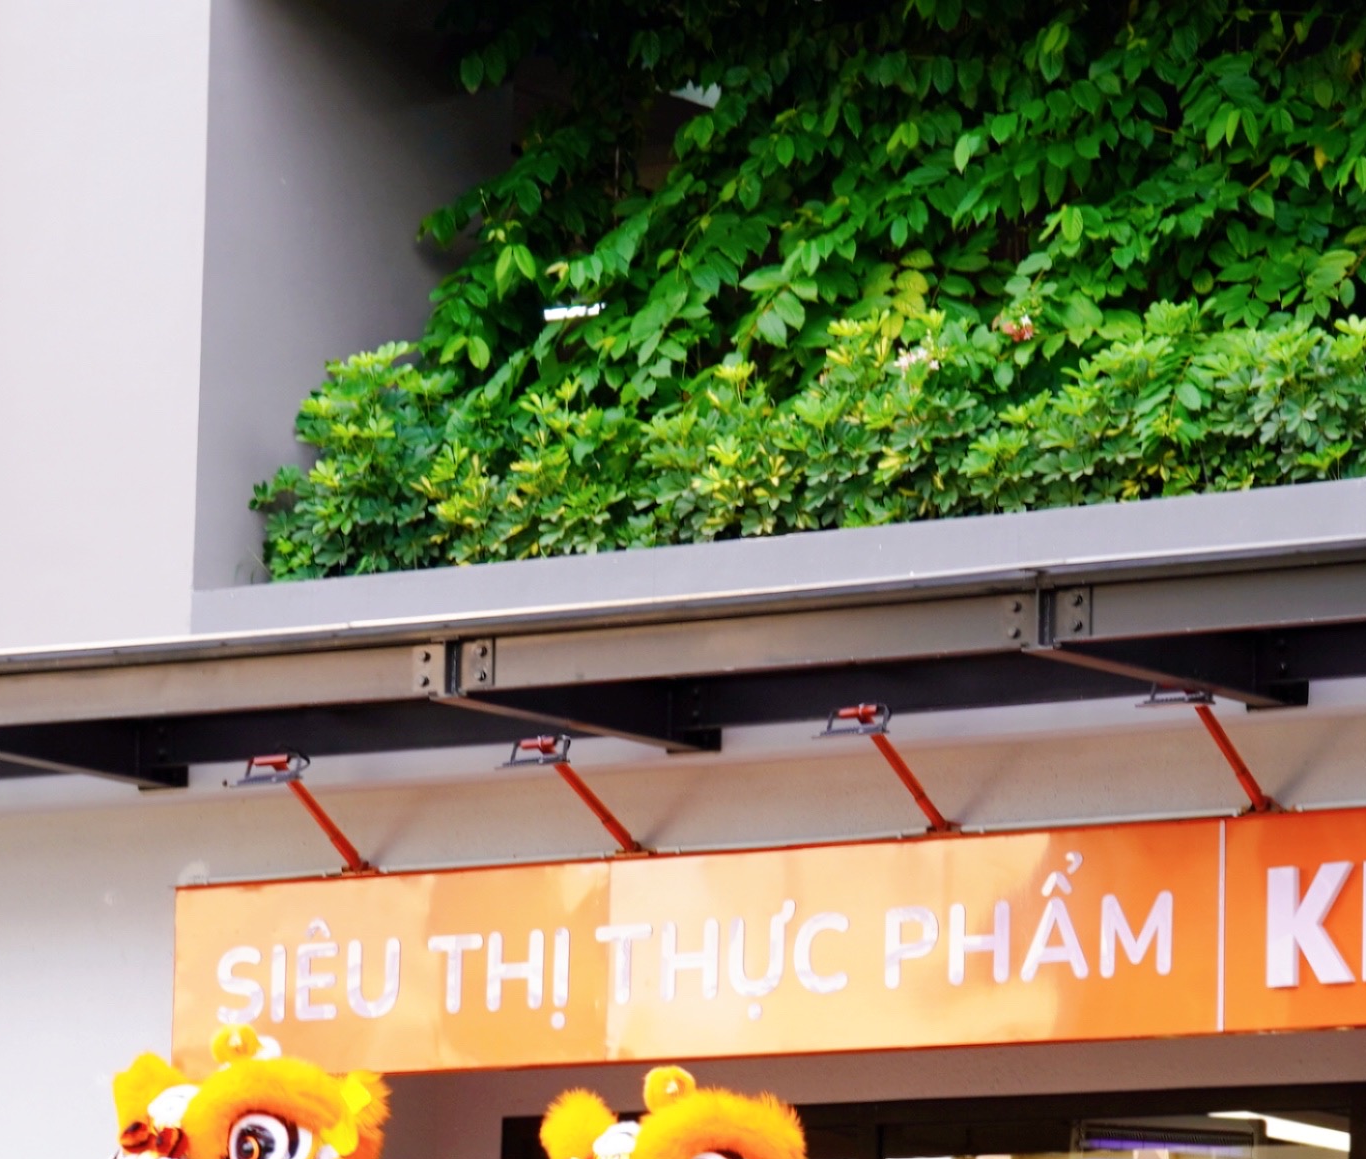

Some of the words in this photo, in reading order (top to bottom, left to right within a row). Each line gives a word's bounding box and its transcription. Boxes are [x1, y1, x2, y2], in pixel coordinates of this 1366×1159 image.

[216, 920, 401, 1025] SIÊU
[428, 927, 570, 1030] THỊ
[596, 899, 850, 1020] THỰC
[883, 851, 1174, 989] PHẨM
